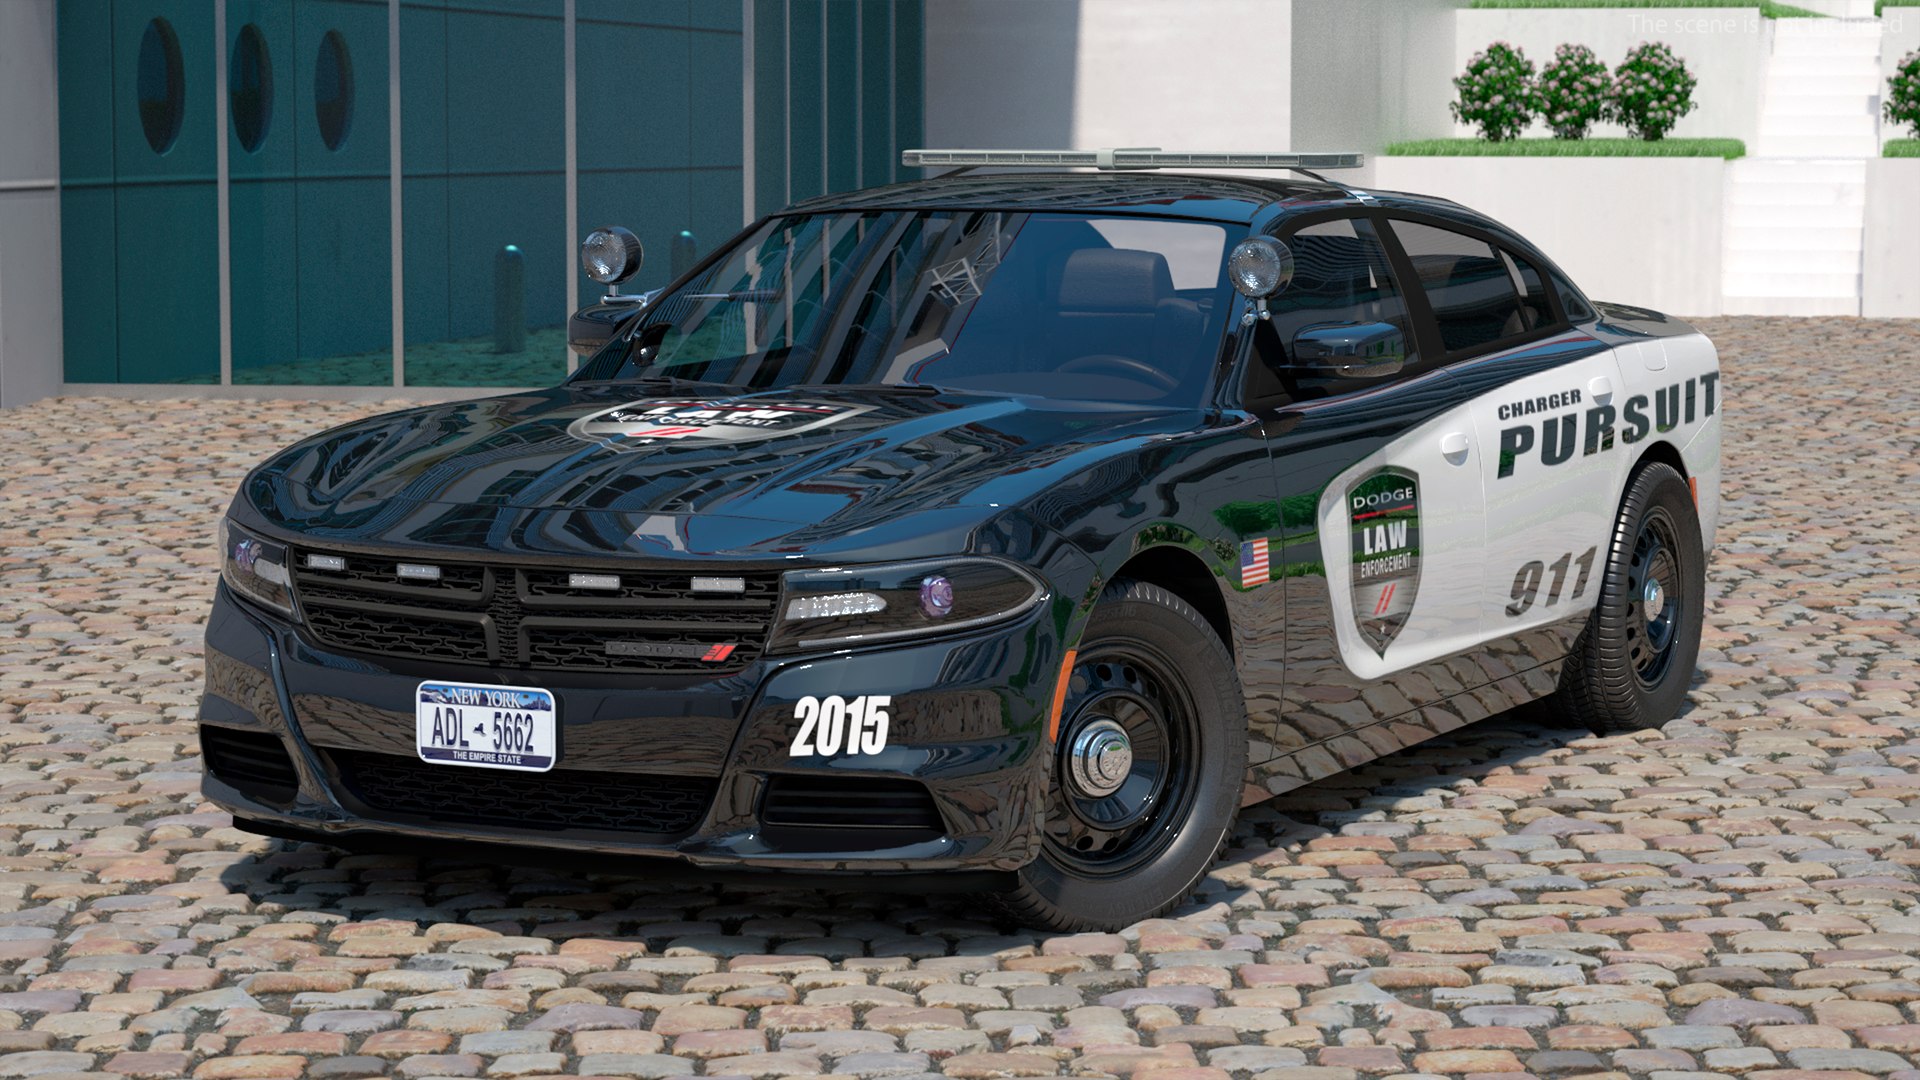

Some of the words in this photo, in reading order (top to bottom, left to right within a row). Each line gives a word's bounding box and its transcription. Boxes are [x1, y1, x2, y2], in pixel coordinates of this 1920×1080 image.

[1497, 388, 1582, 421] CHARGER
[1497, 371, 1720, 480] PURSUIT
[1353, 486, 1414, 510] DODGE
[1363, 519, 1407, 556] LAW
[1361, 551, 1412, 578] ENFORCEMENT
[1505, 545, 1597, 618] 911
[451, 688, 482, 705] NEW
[484, 691, 521, 709] YORK
[432, 706, 469, 747] ADL
[493, 711, 534, 753] 5662
[789, 695, 891, 757] 2015
[453, 751, 467, 760] THE
[469, 752, 496, 763] EMPIRE
[498, 754, 521, 765] STATE
